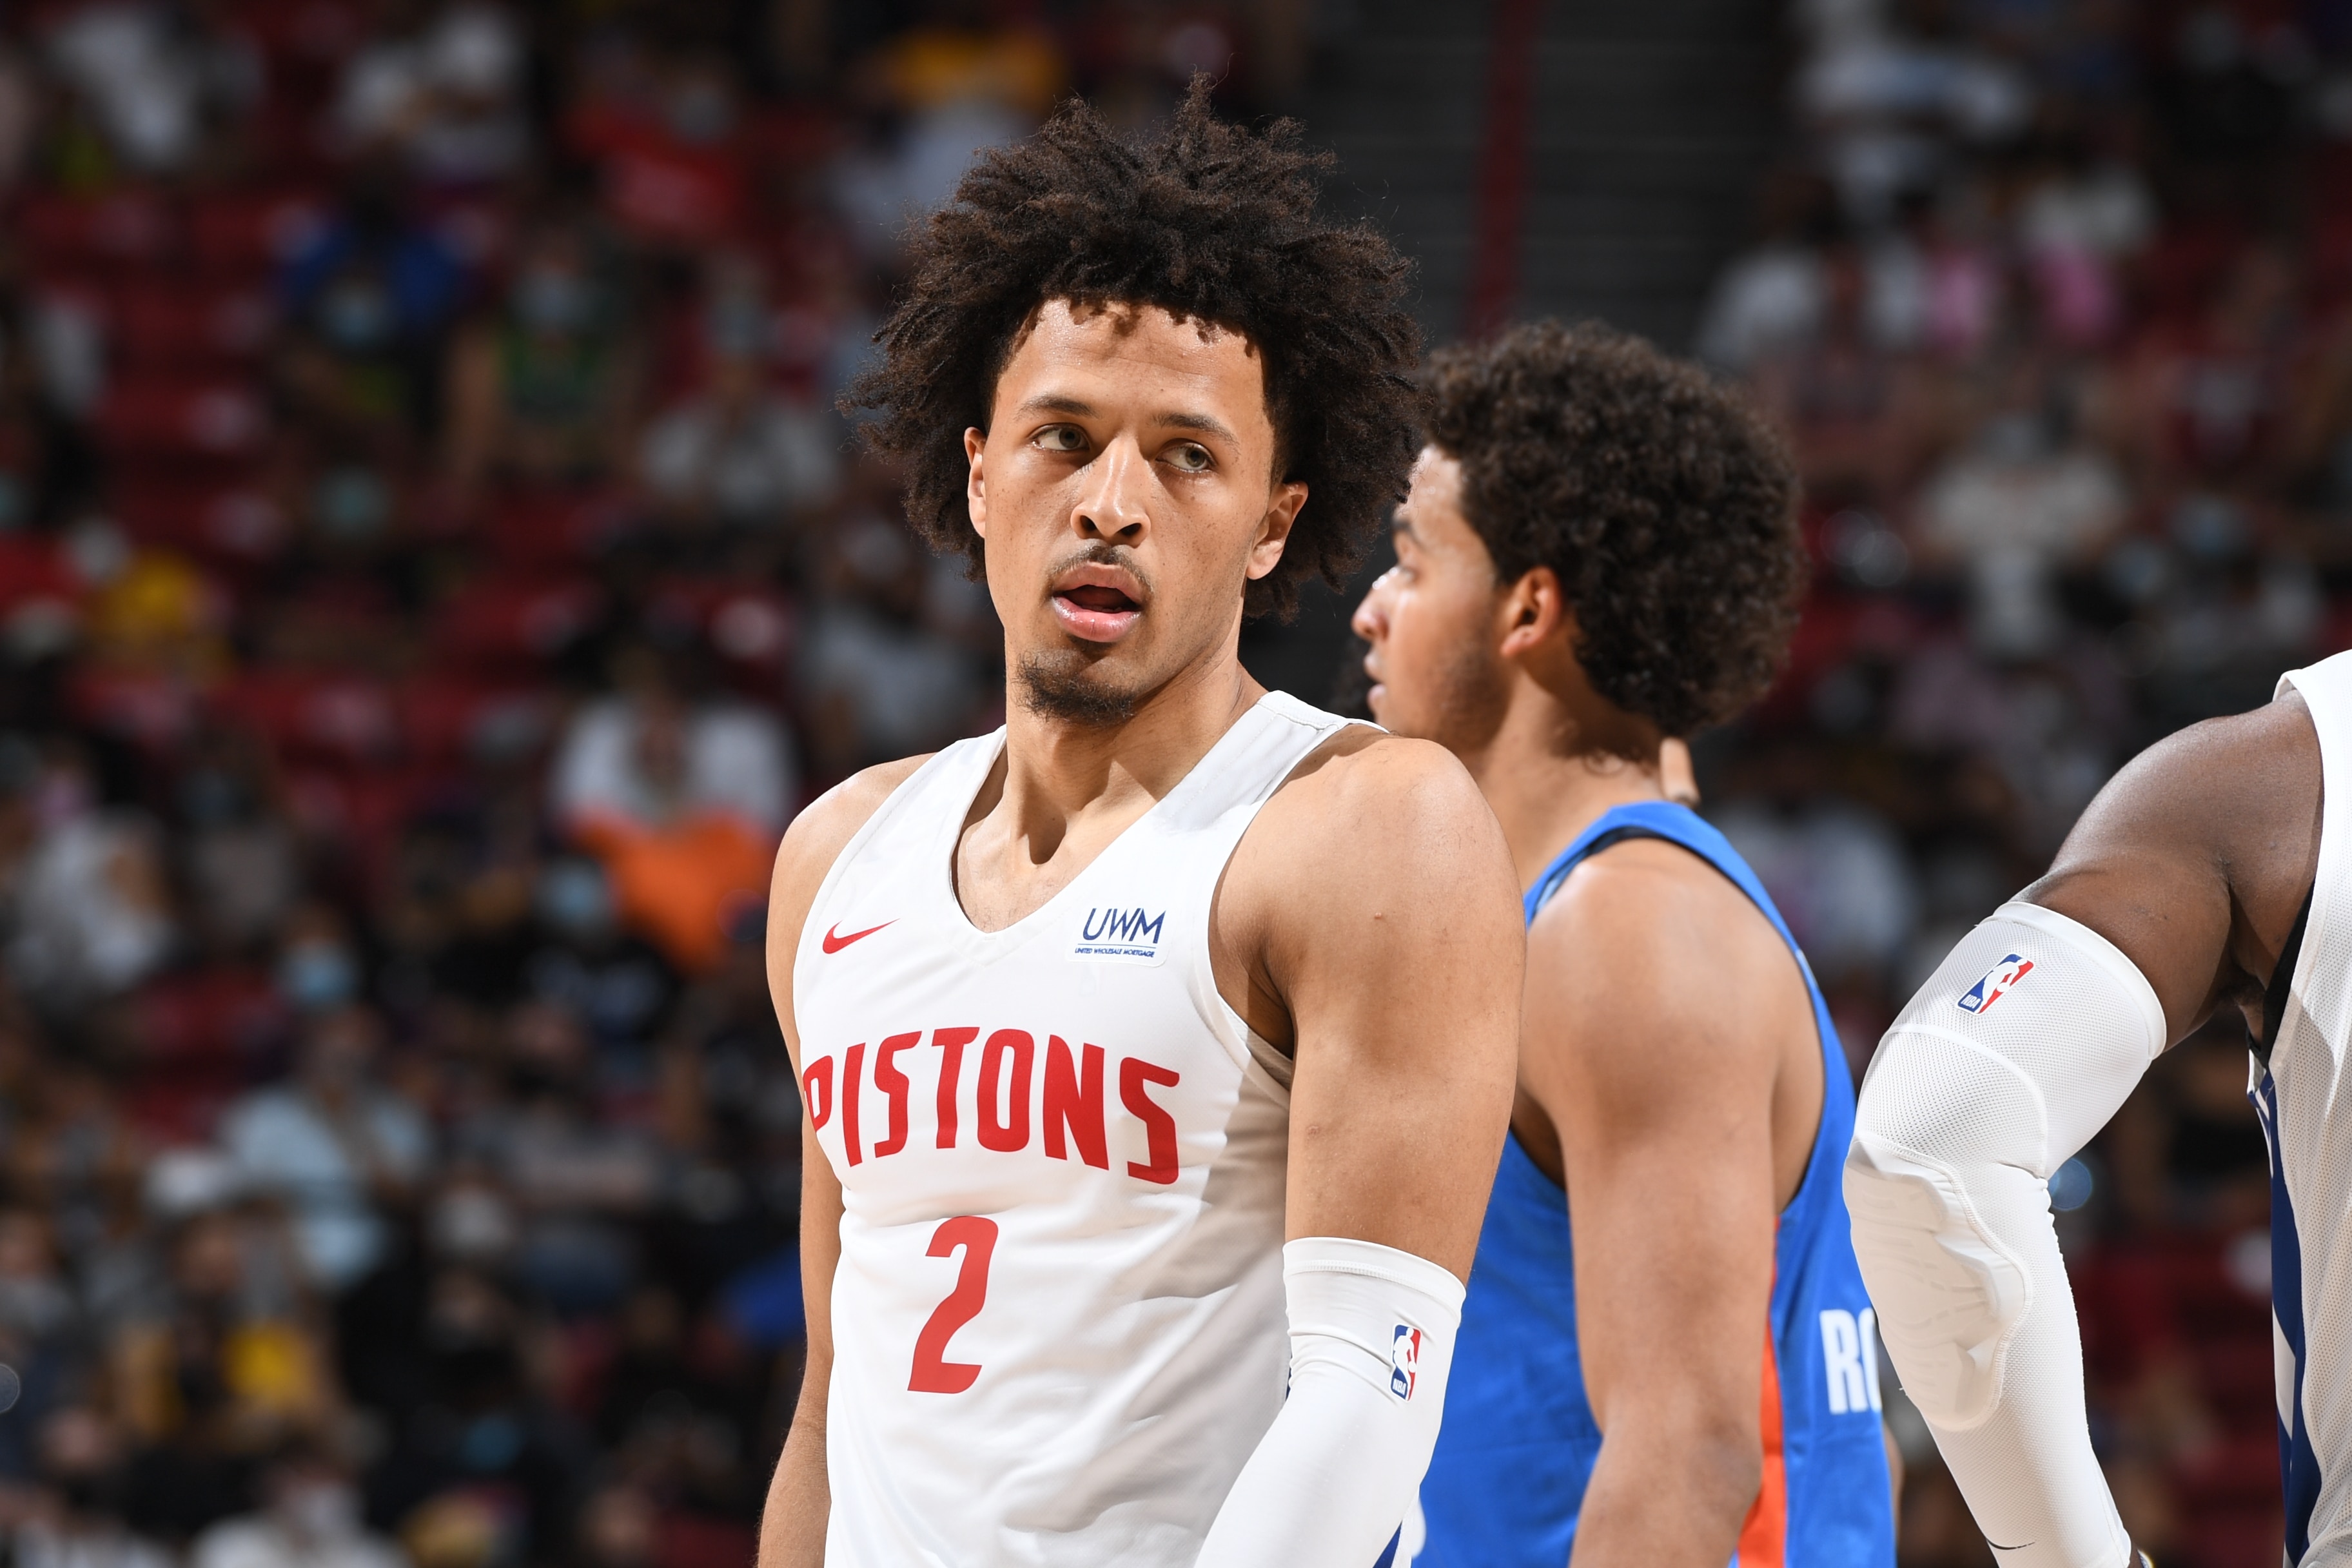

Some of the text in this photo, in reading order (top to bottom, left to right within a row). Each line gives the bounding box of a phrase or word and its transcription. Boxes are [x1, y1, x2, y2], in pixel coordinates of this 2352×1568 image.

[1083, 908, 1166, 944] UWM
[1123, 949, 1155, 957] MORTGAGE
[1960, 994, 1981, 1008] NBA
[803, 1026, 1181, 1185] PISTONS
[907, 1215, 999, 1395] 2
[1393, 1378, 1406, 1395] NBA
